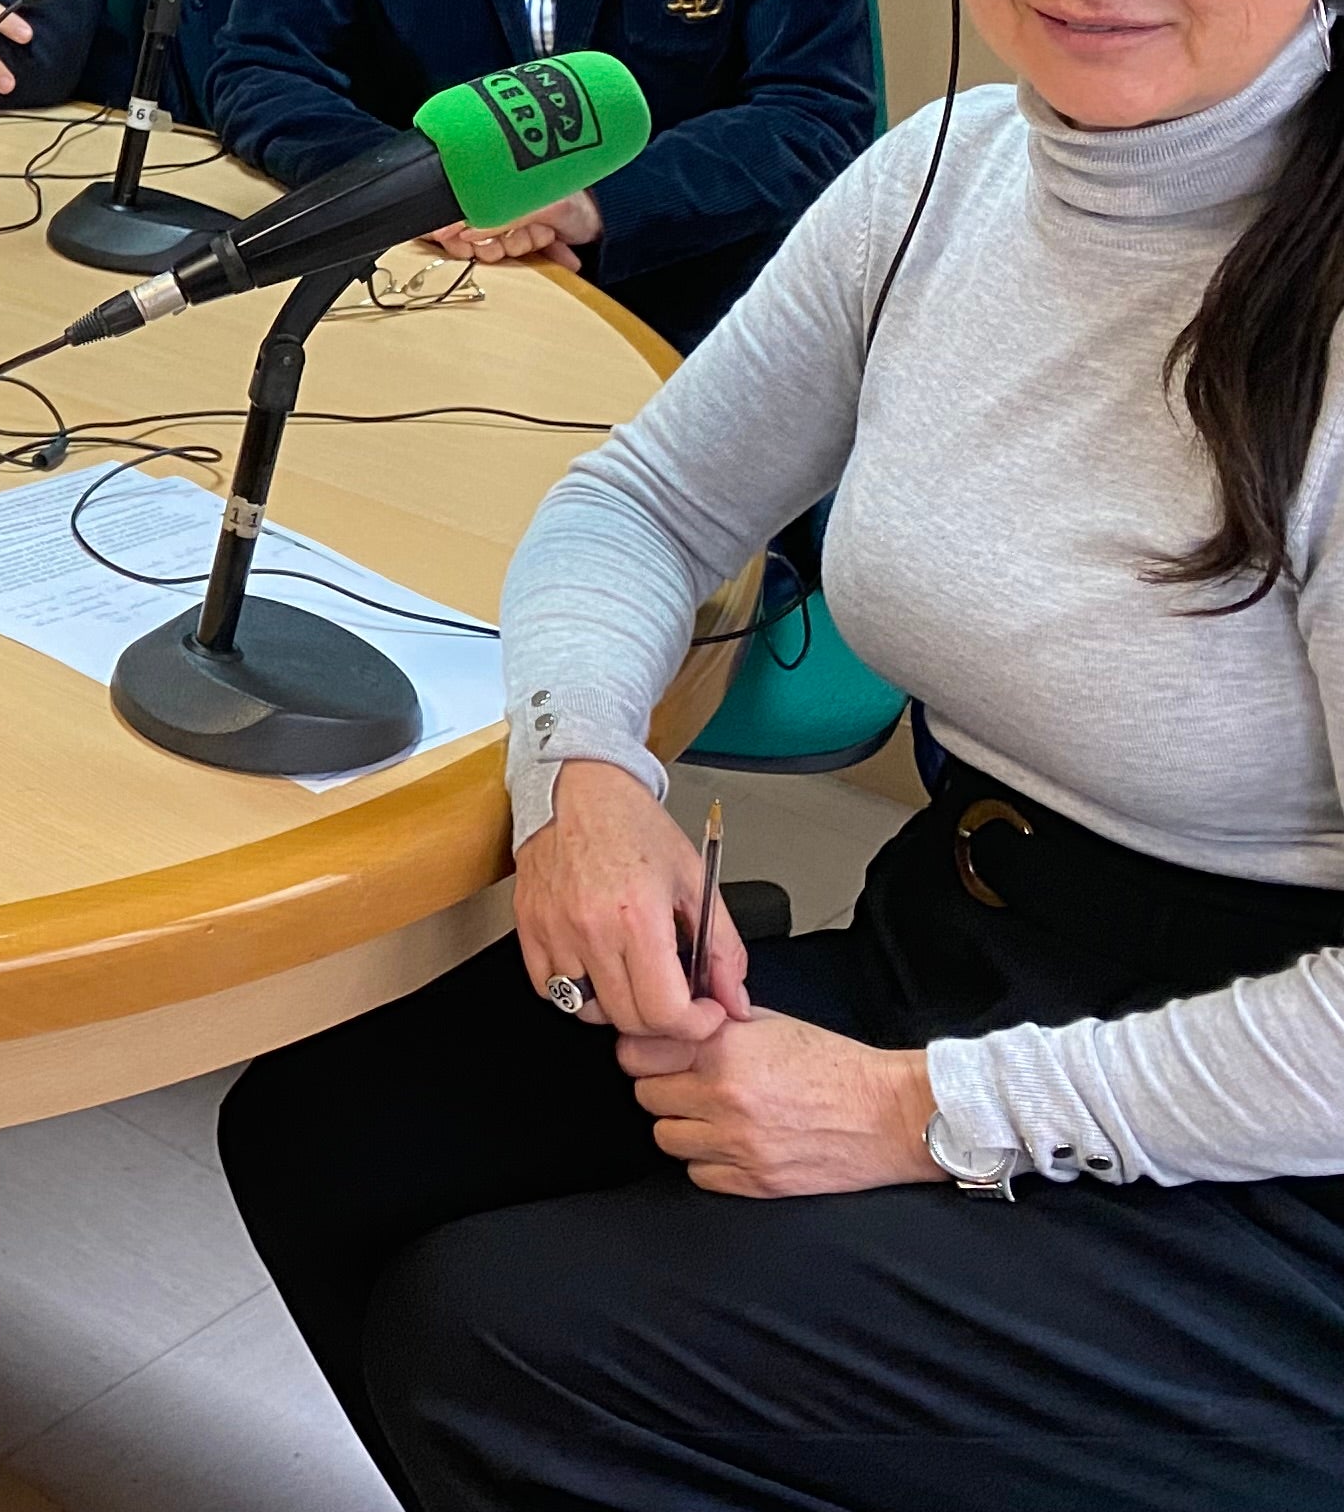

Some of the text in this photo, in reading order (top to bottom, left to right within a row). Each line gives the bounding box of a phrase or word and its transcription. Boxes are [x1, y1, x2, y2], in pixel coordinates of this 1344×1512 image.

[136, 108, 146, 120] 6
[490, 75, 544, 144] CERO
[523, 62, 577, 132] ONDA
